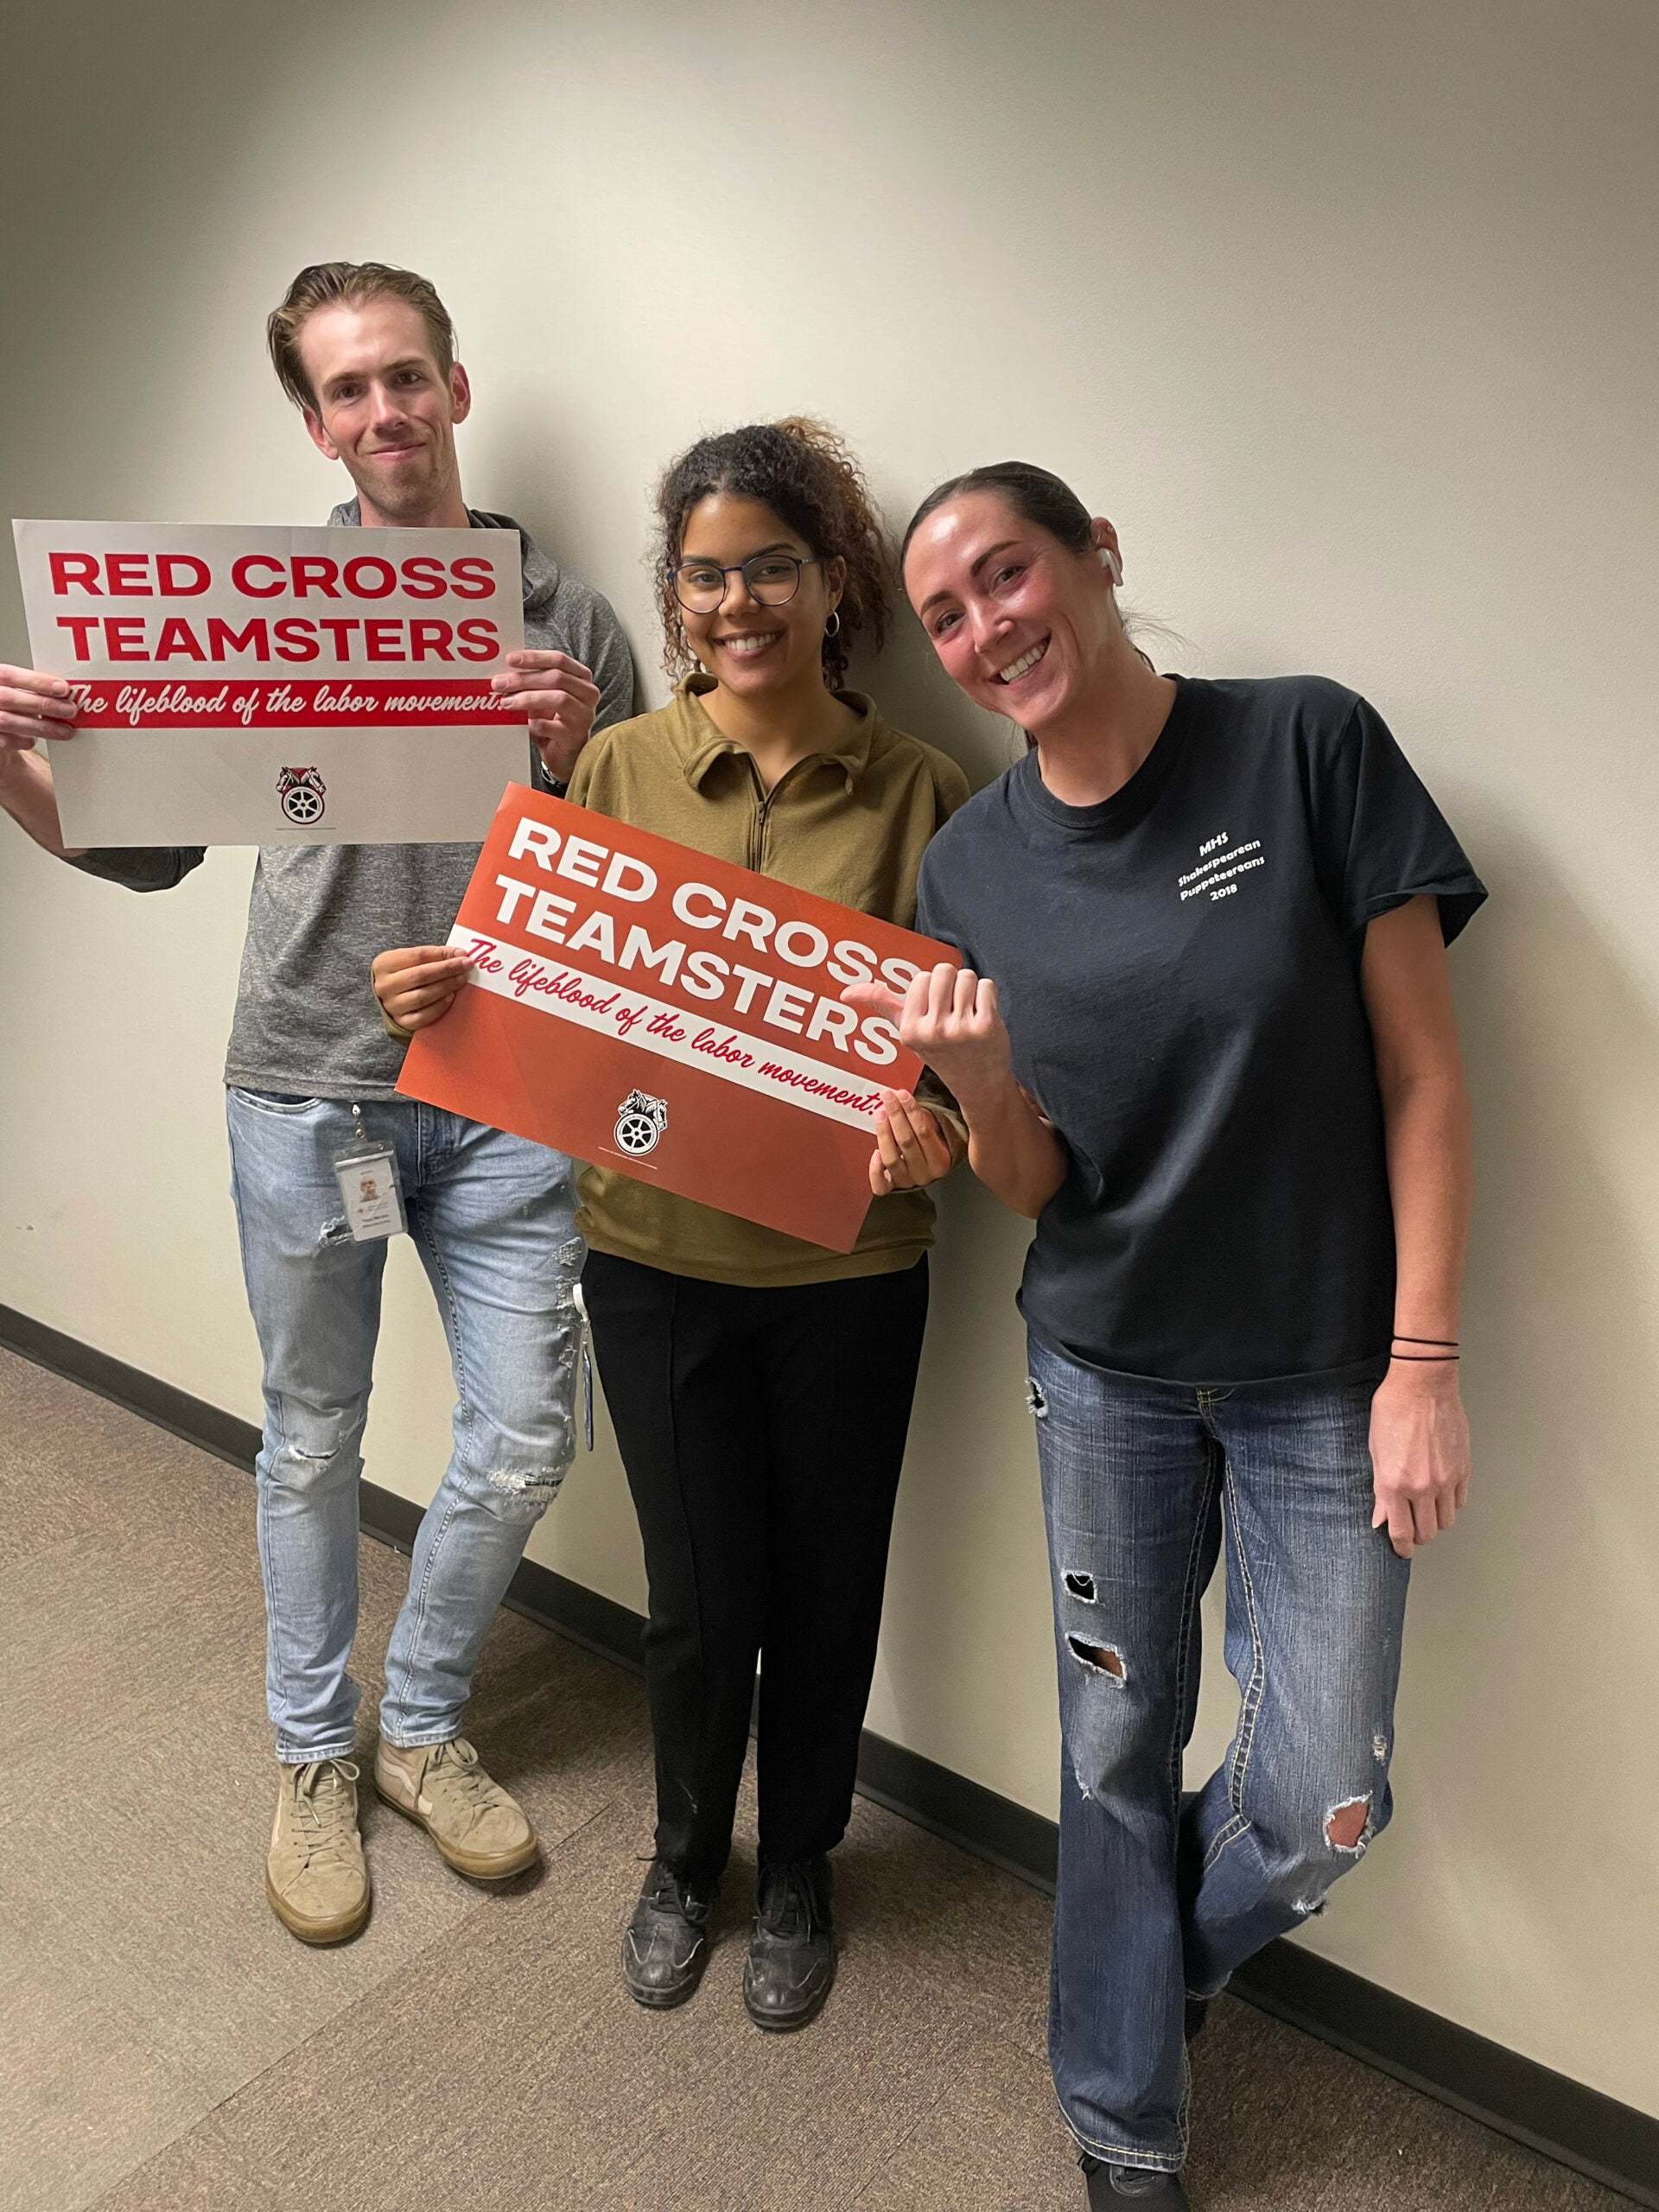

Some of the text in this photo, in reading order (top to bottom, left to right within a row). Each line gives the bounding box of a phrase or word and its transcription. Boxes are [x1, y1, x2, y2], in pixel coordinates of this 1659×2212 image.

[48, 552, 496, 599] RED CROSS
[56, 616, 499, 662] TEAMSTERS
[68, 683, 503, 726] The lifeblood of the labor movement
[1178, 840, 1262, 887] Shakespearean
[1199, 831, 1229, 856] MHS
[1179, 856, 1265, 901] Puppeteereans
[1210, 883, 1237, 901] 2018
[507, 817, 922, 1001] RED CROSS
[495, 875, 899, 1065] TEAMSTERS
[467, 938, 884, 1116] The lifeblood of the labor movement!
